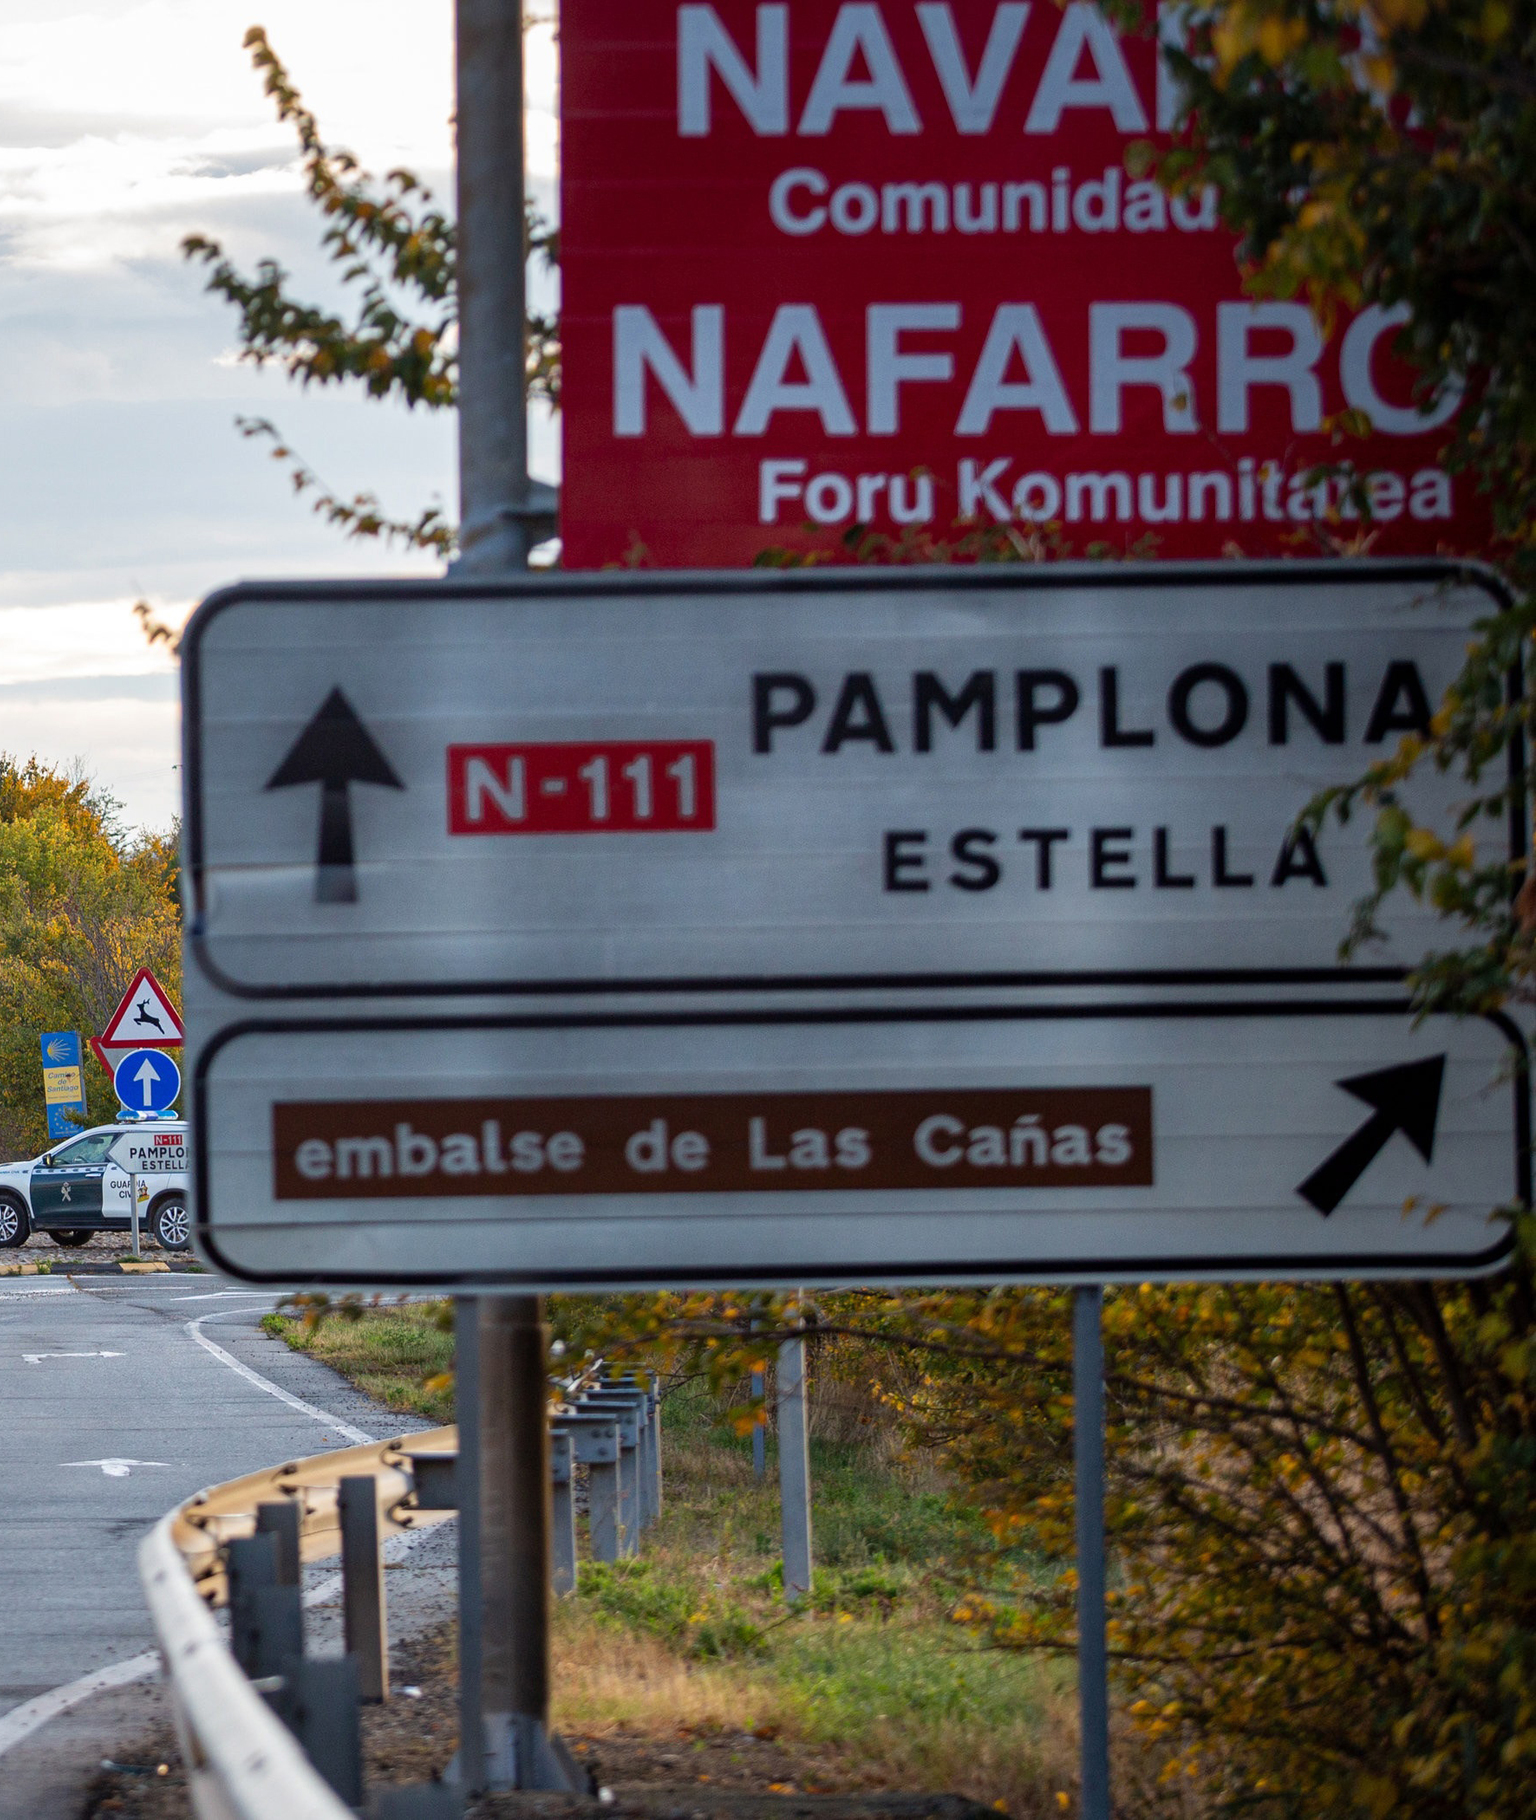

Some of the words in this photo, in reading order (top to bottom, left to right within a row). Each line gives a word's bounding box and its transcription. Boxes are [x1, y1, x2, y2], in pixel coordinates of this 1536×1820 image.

[611, 301, 1496, 438] NAFARRO
[758, 457, 936, 524] Foru
[956, 457, 1453, 524] Komunitatea
[750, 660, 1436, 756] PAMPLONA
[466, 754, 697, 822] N-111
[882, 825, 1330, 893] ESTELLA
[47, 1084, 79, 1092] Santiago
[155, 1135, 182, 1145] N-111
[294, 1119, 585, 1180] embalse
[624, 1117, 711, 1172] de
[748, 1116, 872, 1171] Las
[912, 1112, 1132, 1168] Cañas
[110, 1180, 146, 1189] GUARIA
[118, 1190, 139, 1199] CIV
